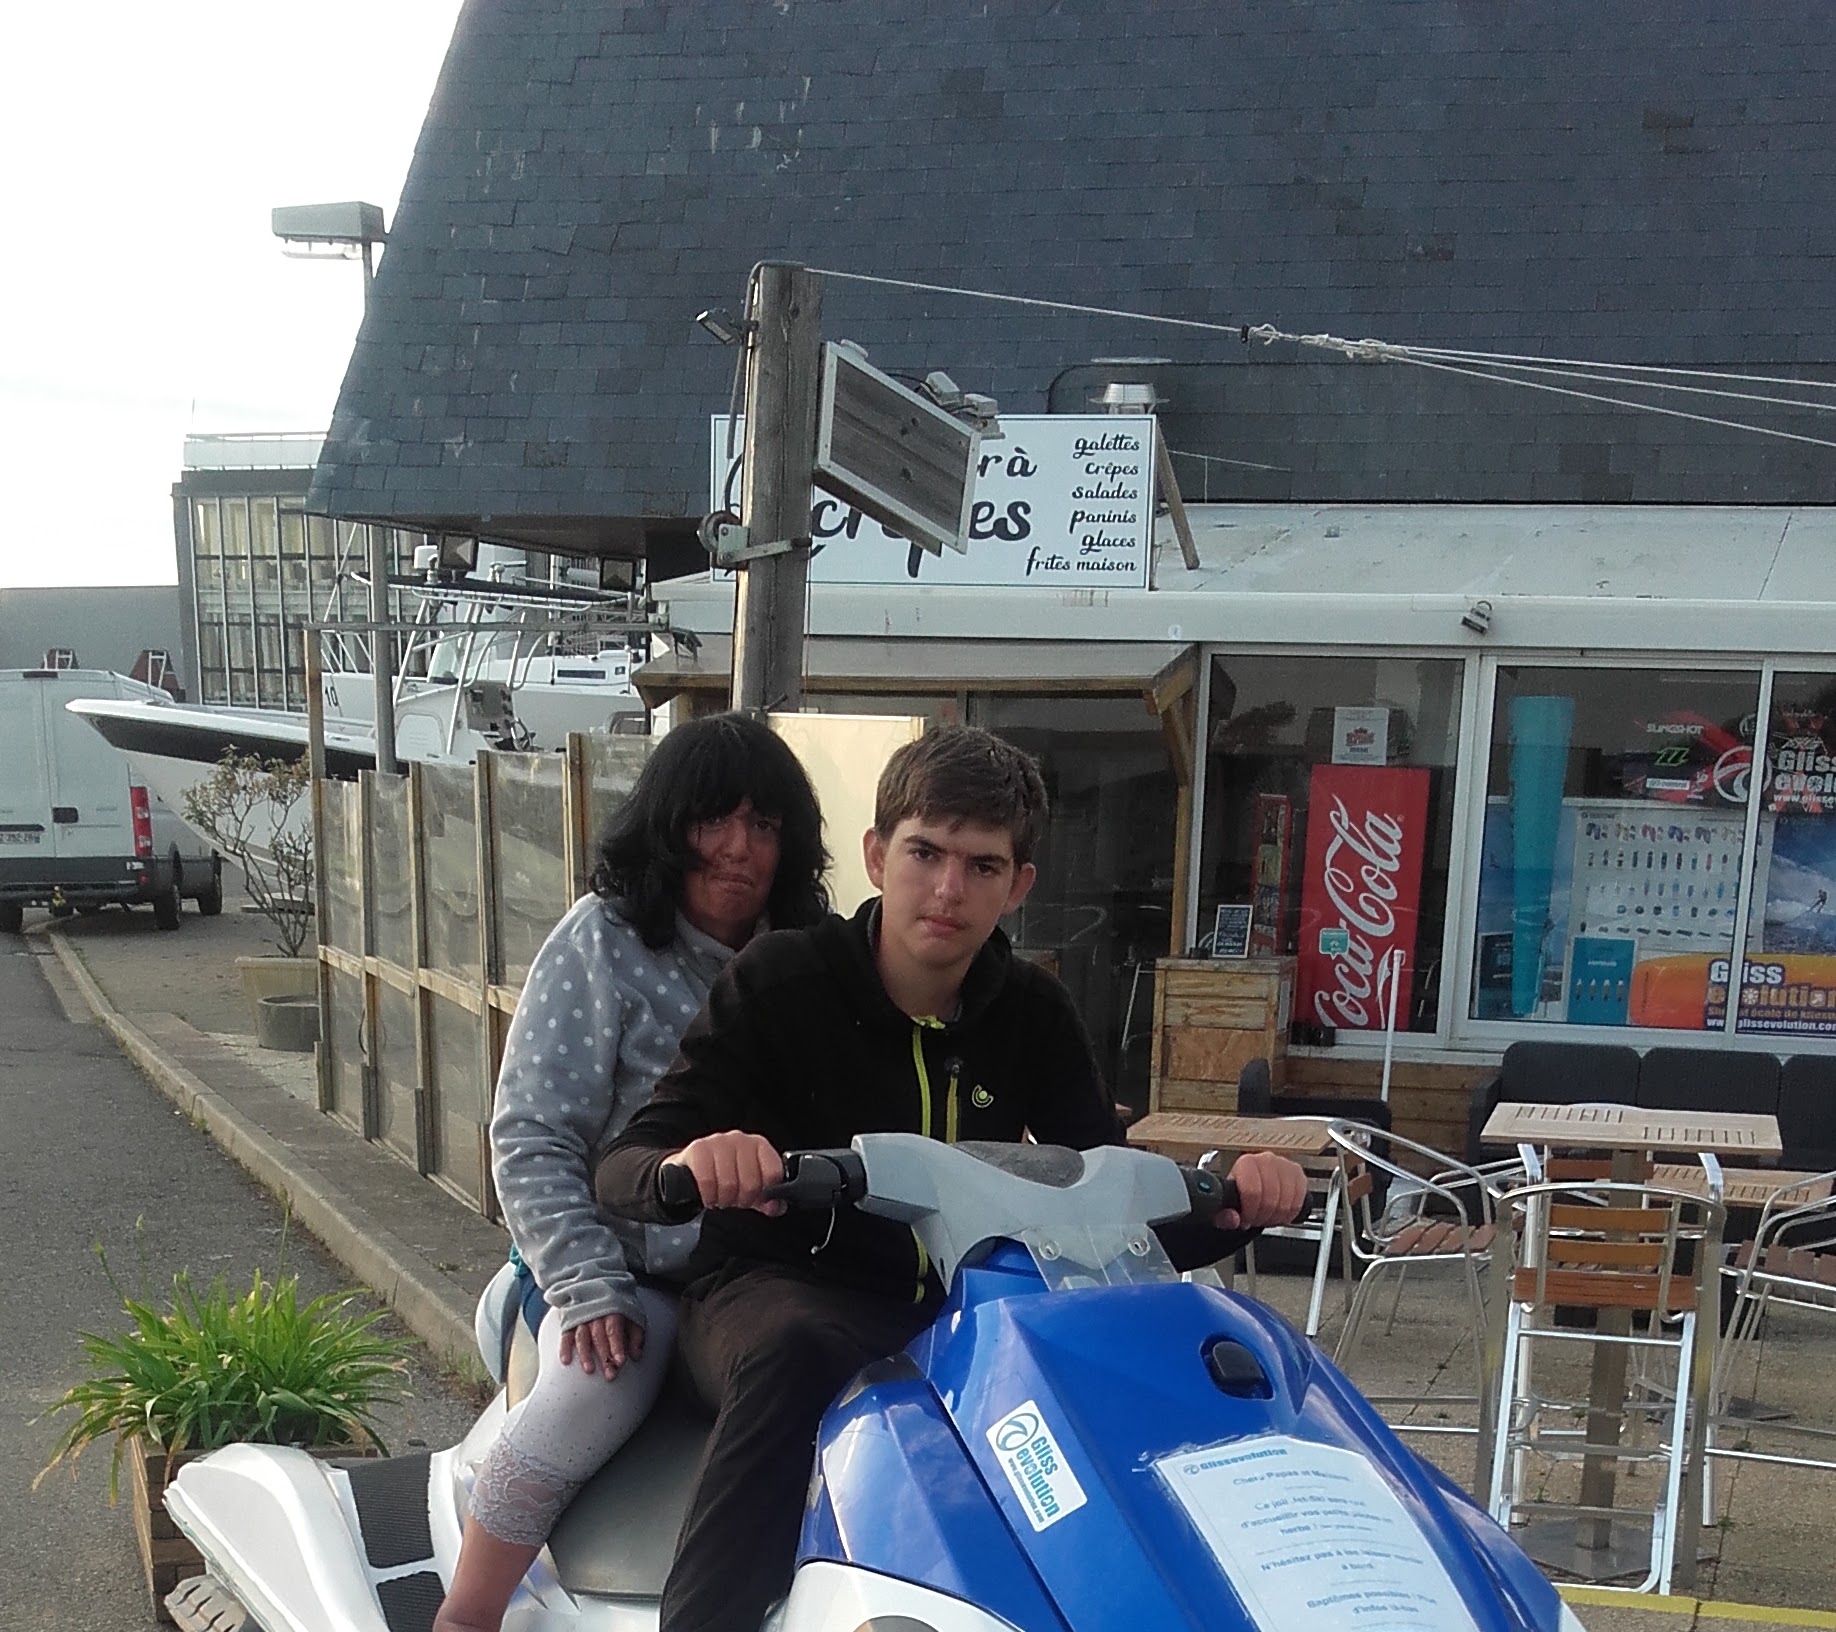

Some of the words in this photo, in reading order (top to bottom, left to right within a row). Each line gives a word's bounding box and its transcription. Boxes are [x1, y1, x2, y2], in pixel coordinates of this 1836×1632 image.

[1072, 433, 1140, 459] galettes
[1085, 462, 1139, 483] crêpes
[1072, 481, 1138, 499] salades
[1069, 510, 1137, 534] paninis
[1079, 530, 1136, 555] glaces
[1026, 546, 1071, 576] frites
[1076, 558, 1137, 571] maison
[1711, 961, 1783, 984] Giss
[1031, 1436, 1058, 1475] Gliss
[1200, 1448, 1288, 1470] Glissevolution
[1016, 1447, 1060, 1517] evolution
